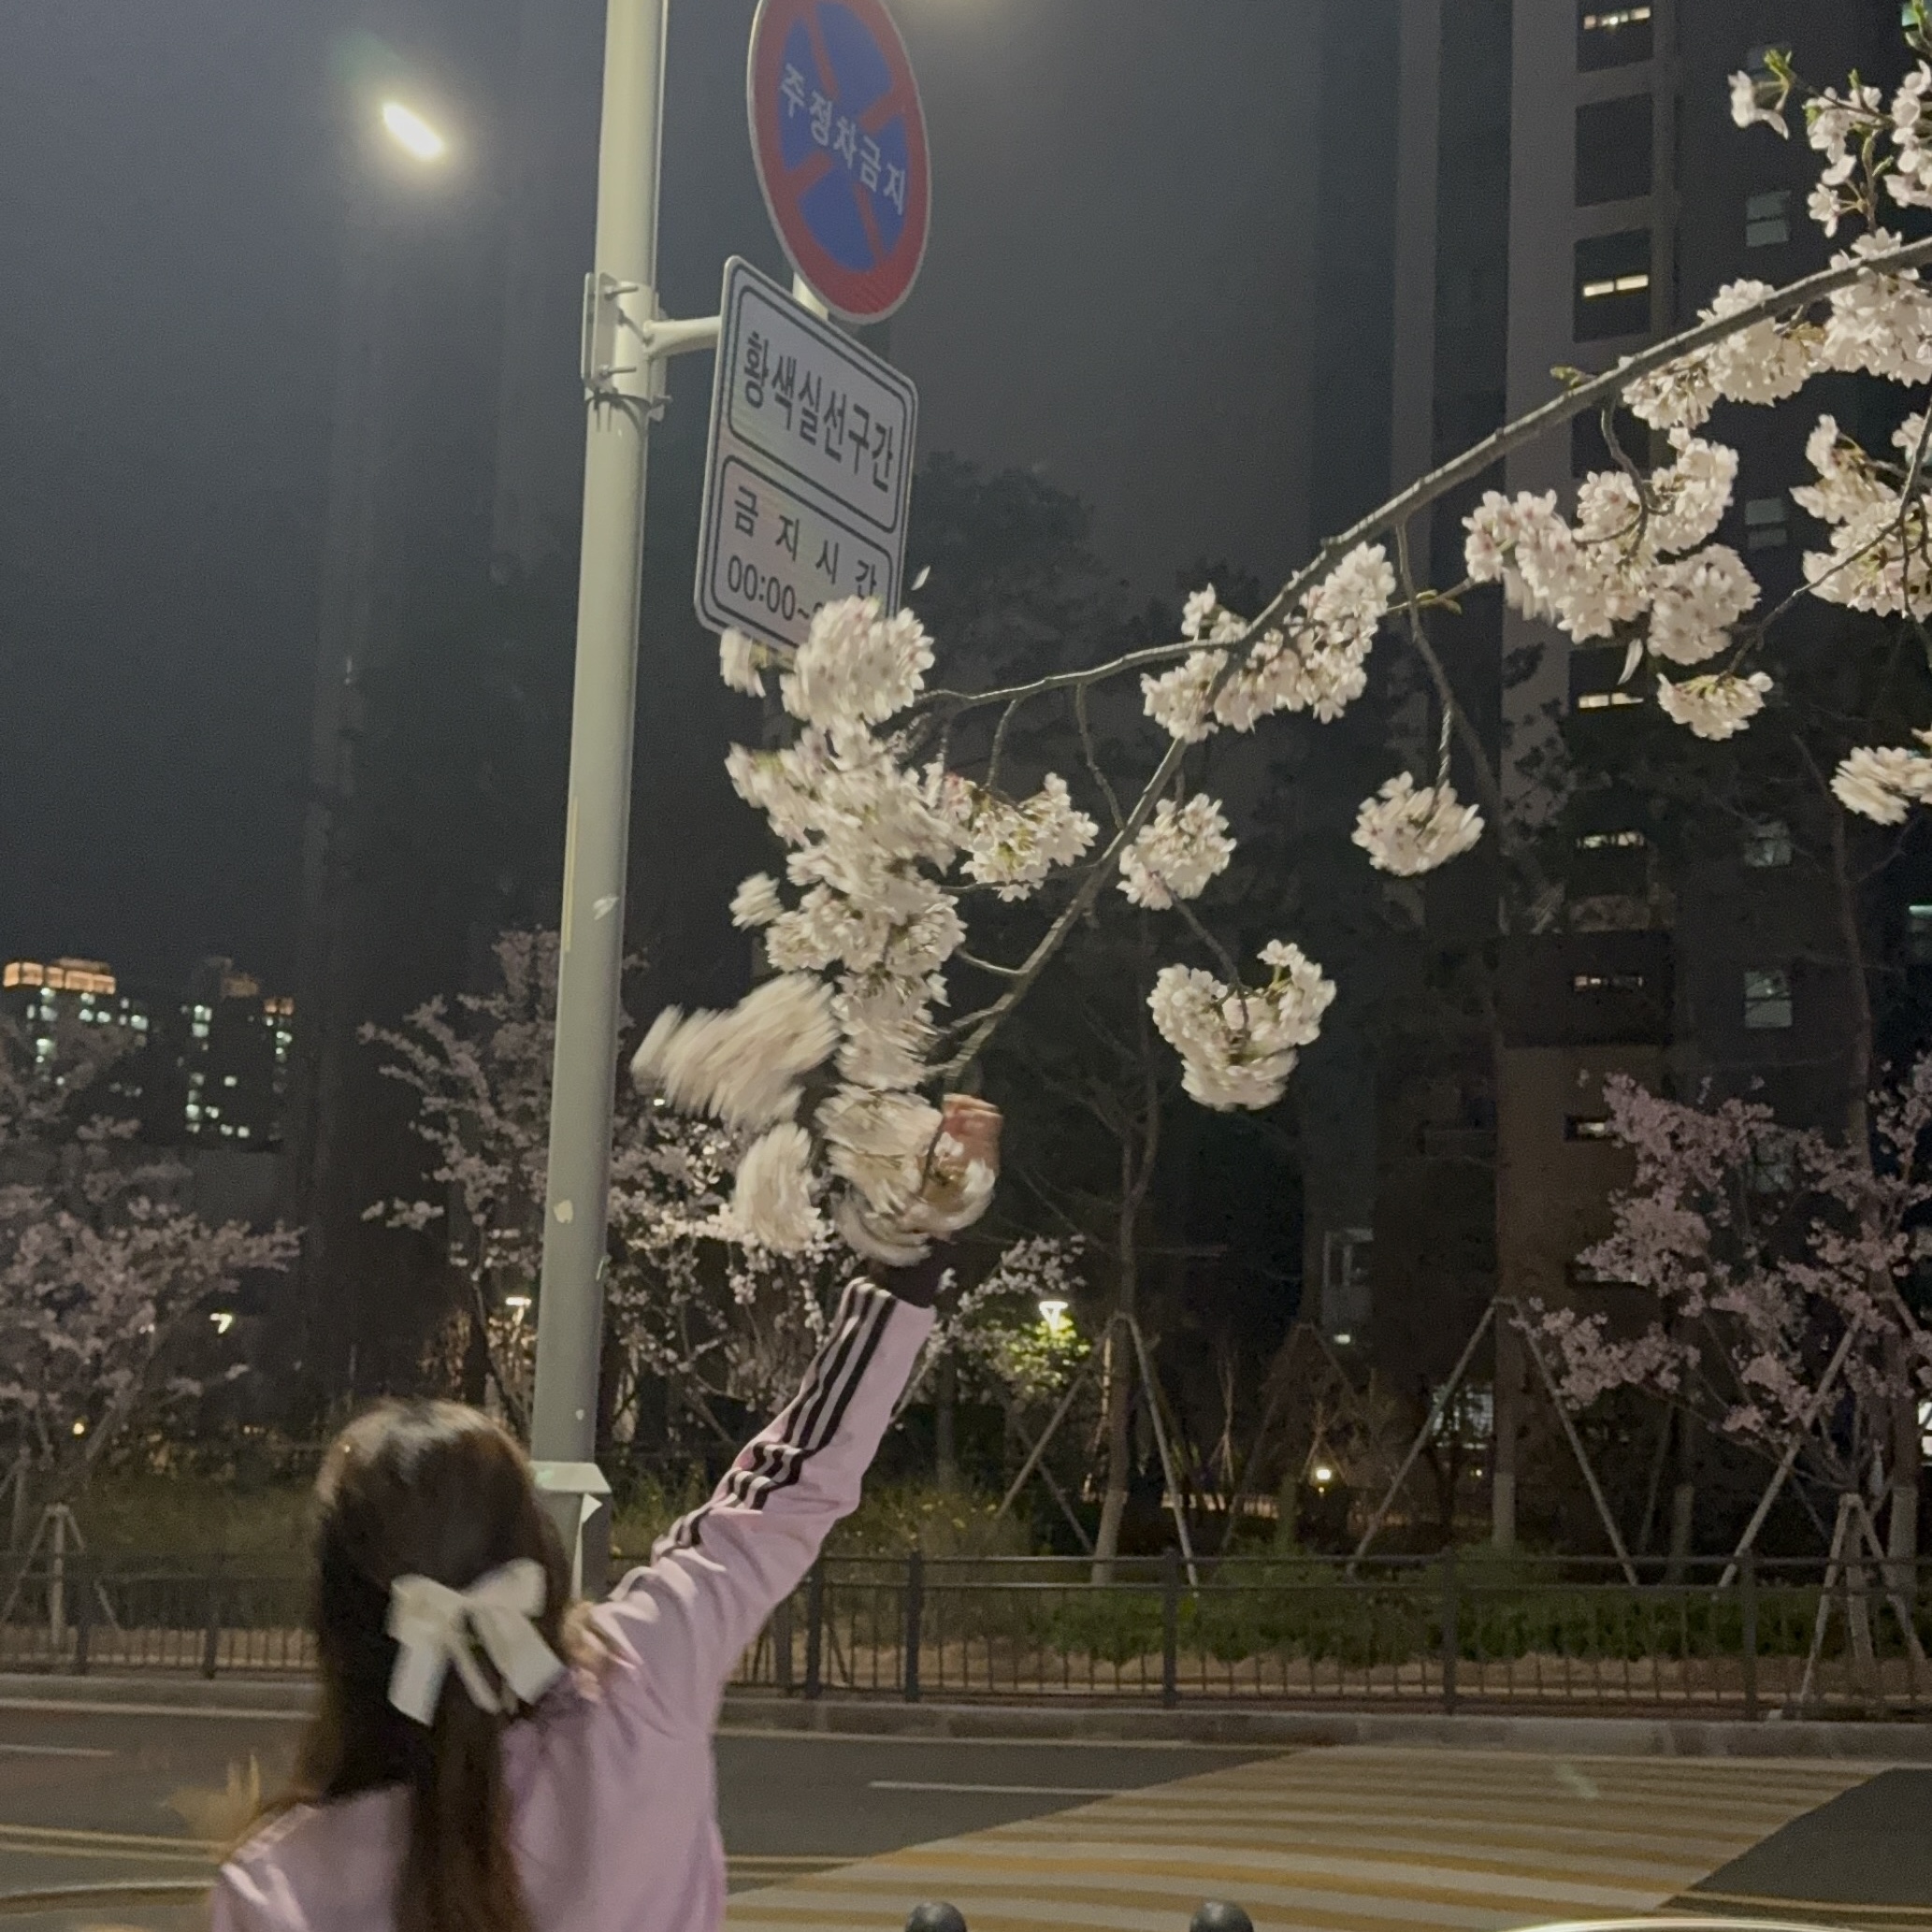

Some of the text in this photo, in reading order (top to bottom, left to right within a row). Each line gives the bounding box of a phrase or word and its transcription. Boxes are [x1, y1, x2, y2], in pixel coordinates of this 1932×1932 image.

[782, 63, 905, 215] 주정차금지
[744, 331, 893, 493] 황색실선구간
[728, 555, 823, 621] 00:00~
